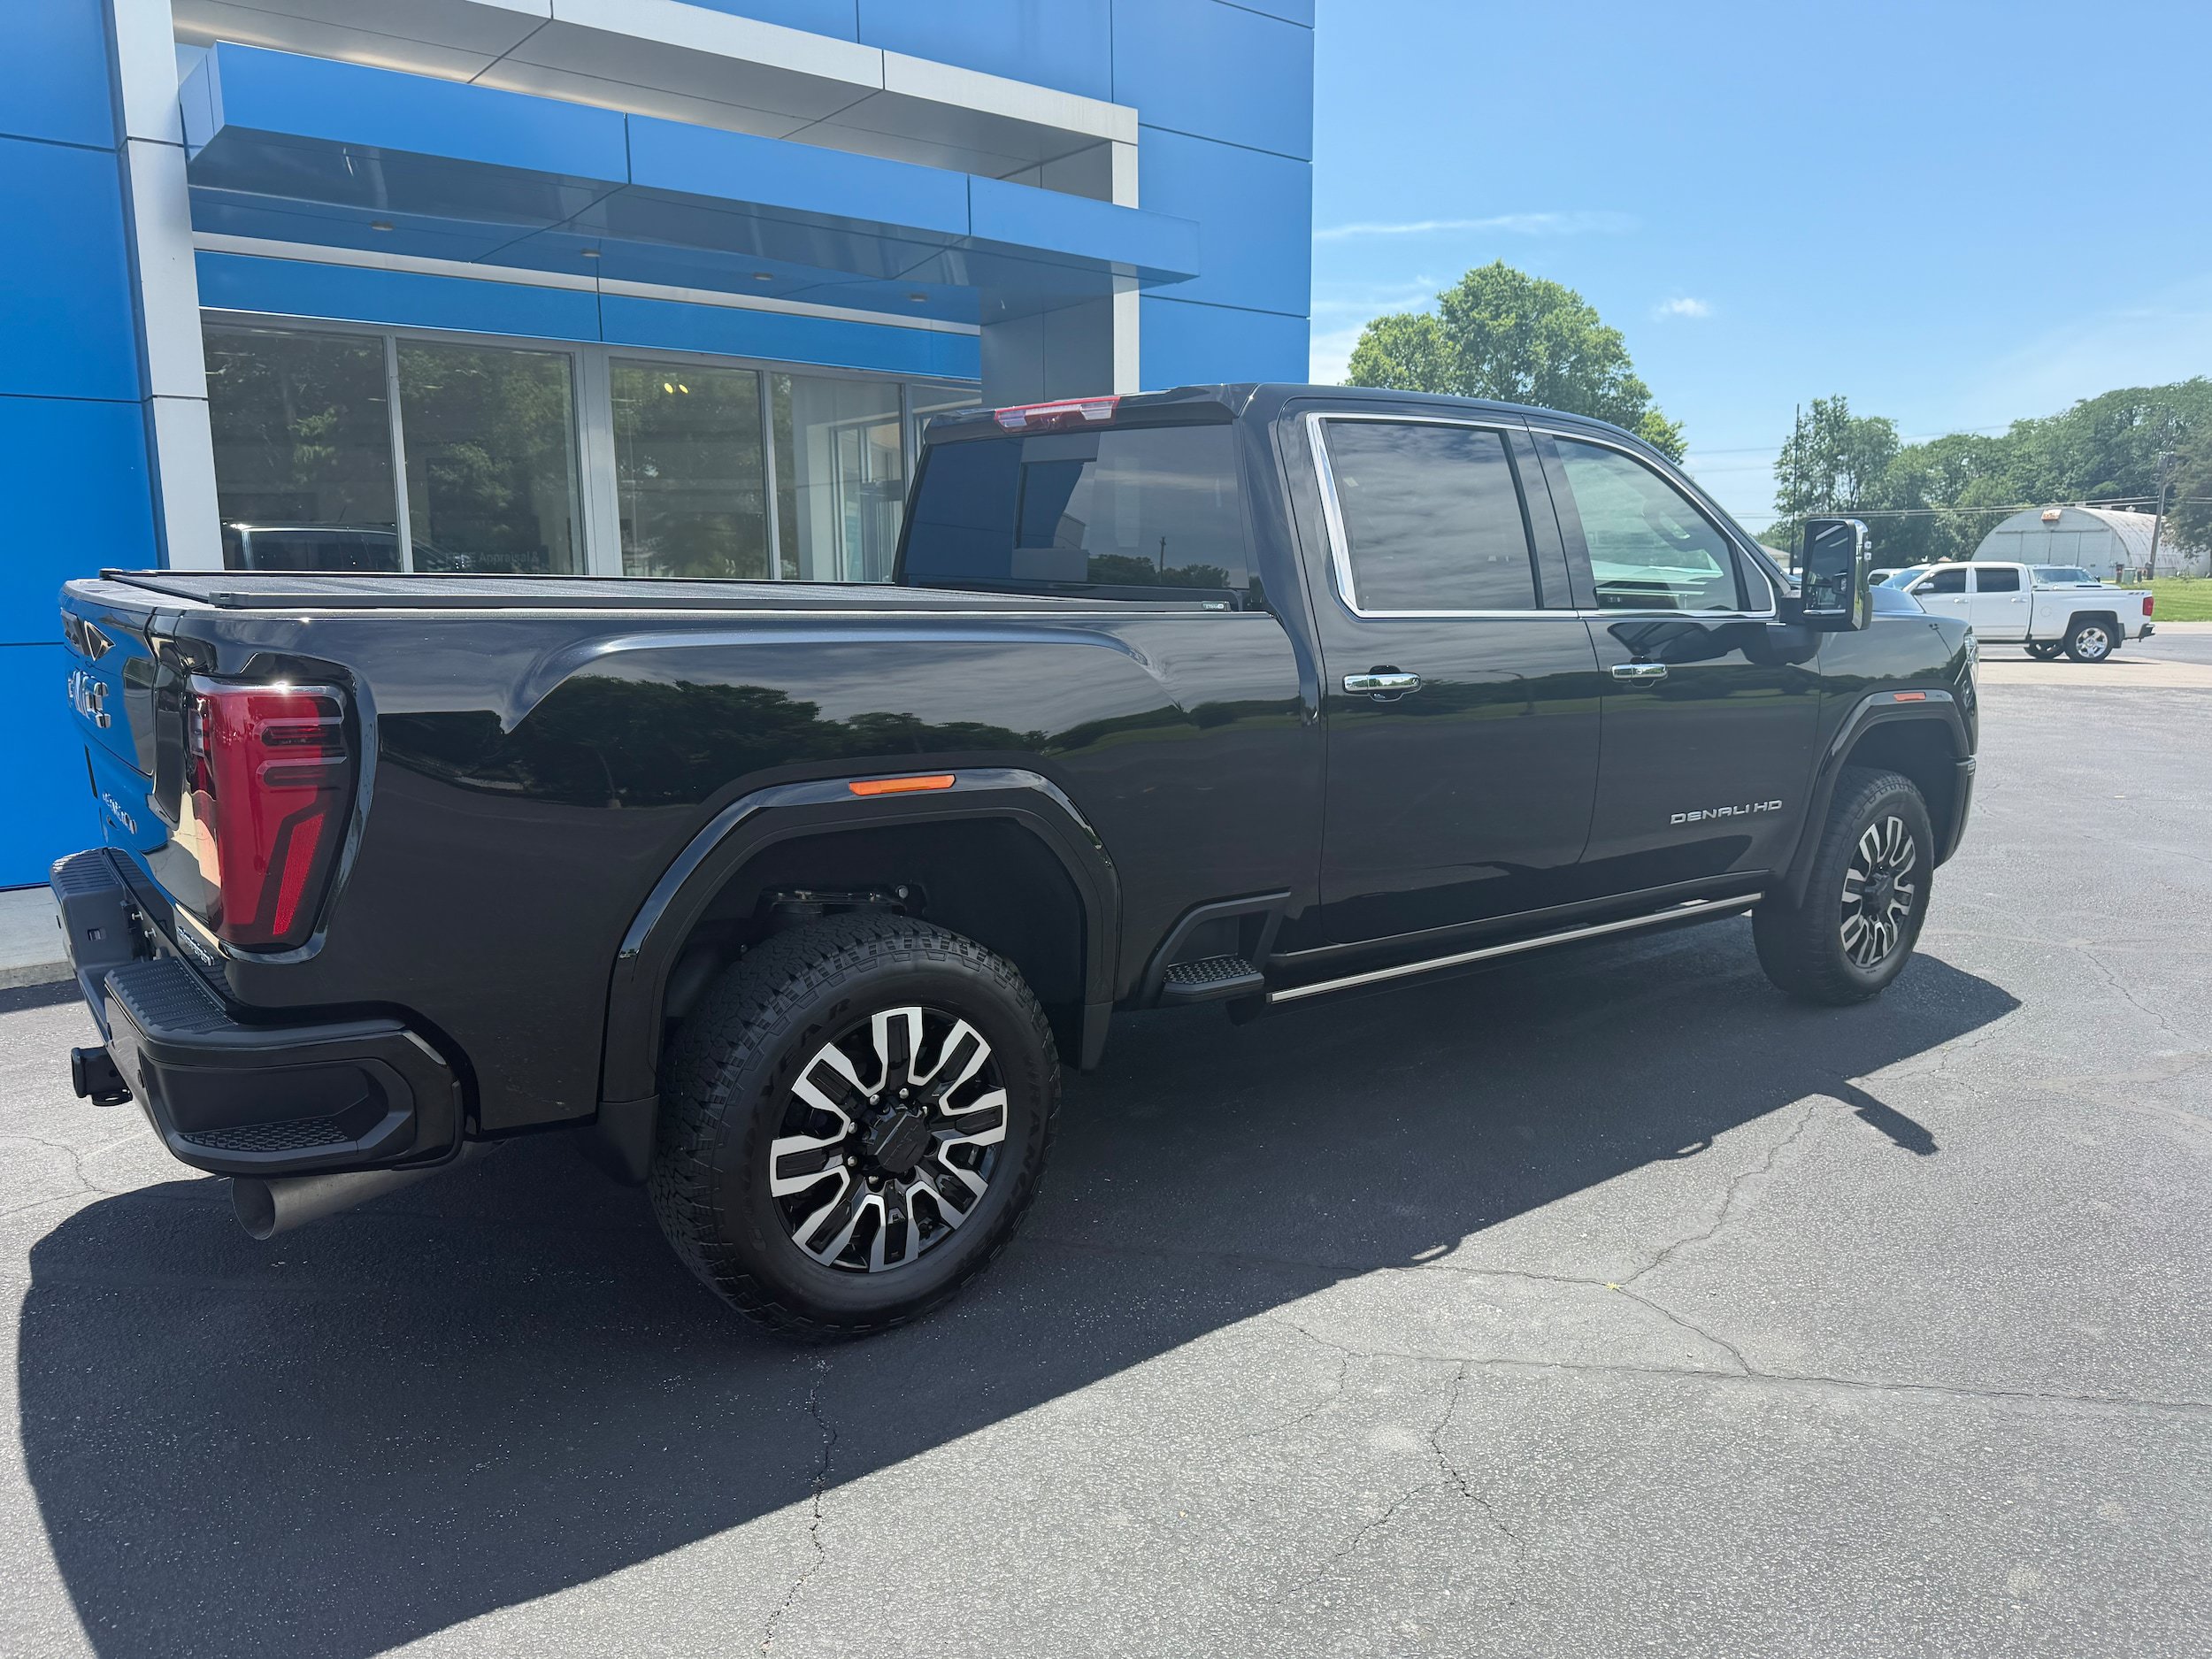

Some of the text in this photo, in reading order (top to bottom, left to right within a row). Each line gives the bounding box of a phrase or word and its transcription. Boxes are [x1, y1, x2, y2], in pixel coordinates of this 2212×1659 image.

[478, 550, 530, 566] Appraisal
[1670, 799, 1783, 825] DENALI HD
